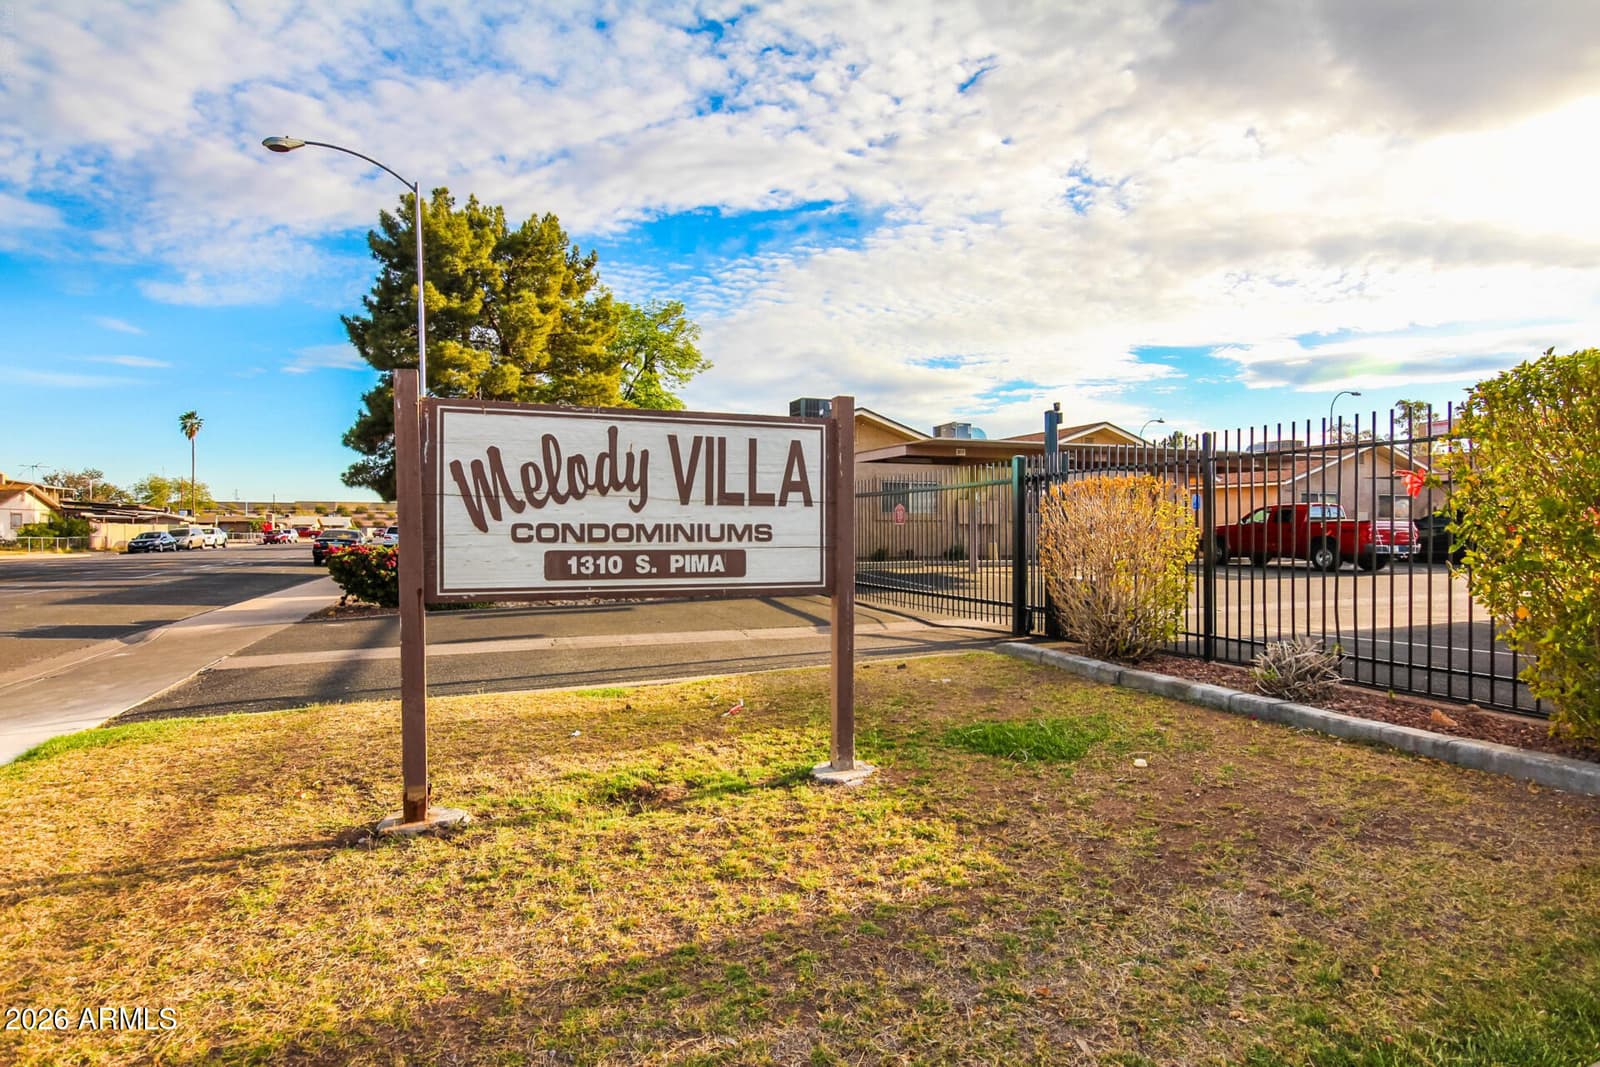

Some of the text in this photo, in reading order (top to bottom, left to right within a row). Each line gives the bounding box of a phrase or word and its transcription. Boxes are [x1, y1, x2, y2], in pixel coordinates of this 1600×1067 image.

[449, 425, 813, 533] Melody VILLA
[510, 522, 773, 543] CONDOMINIUMS
[567, 554, 725, 575] 1310 S. PIMA
